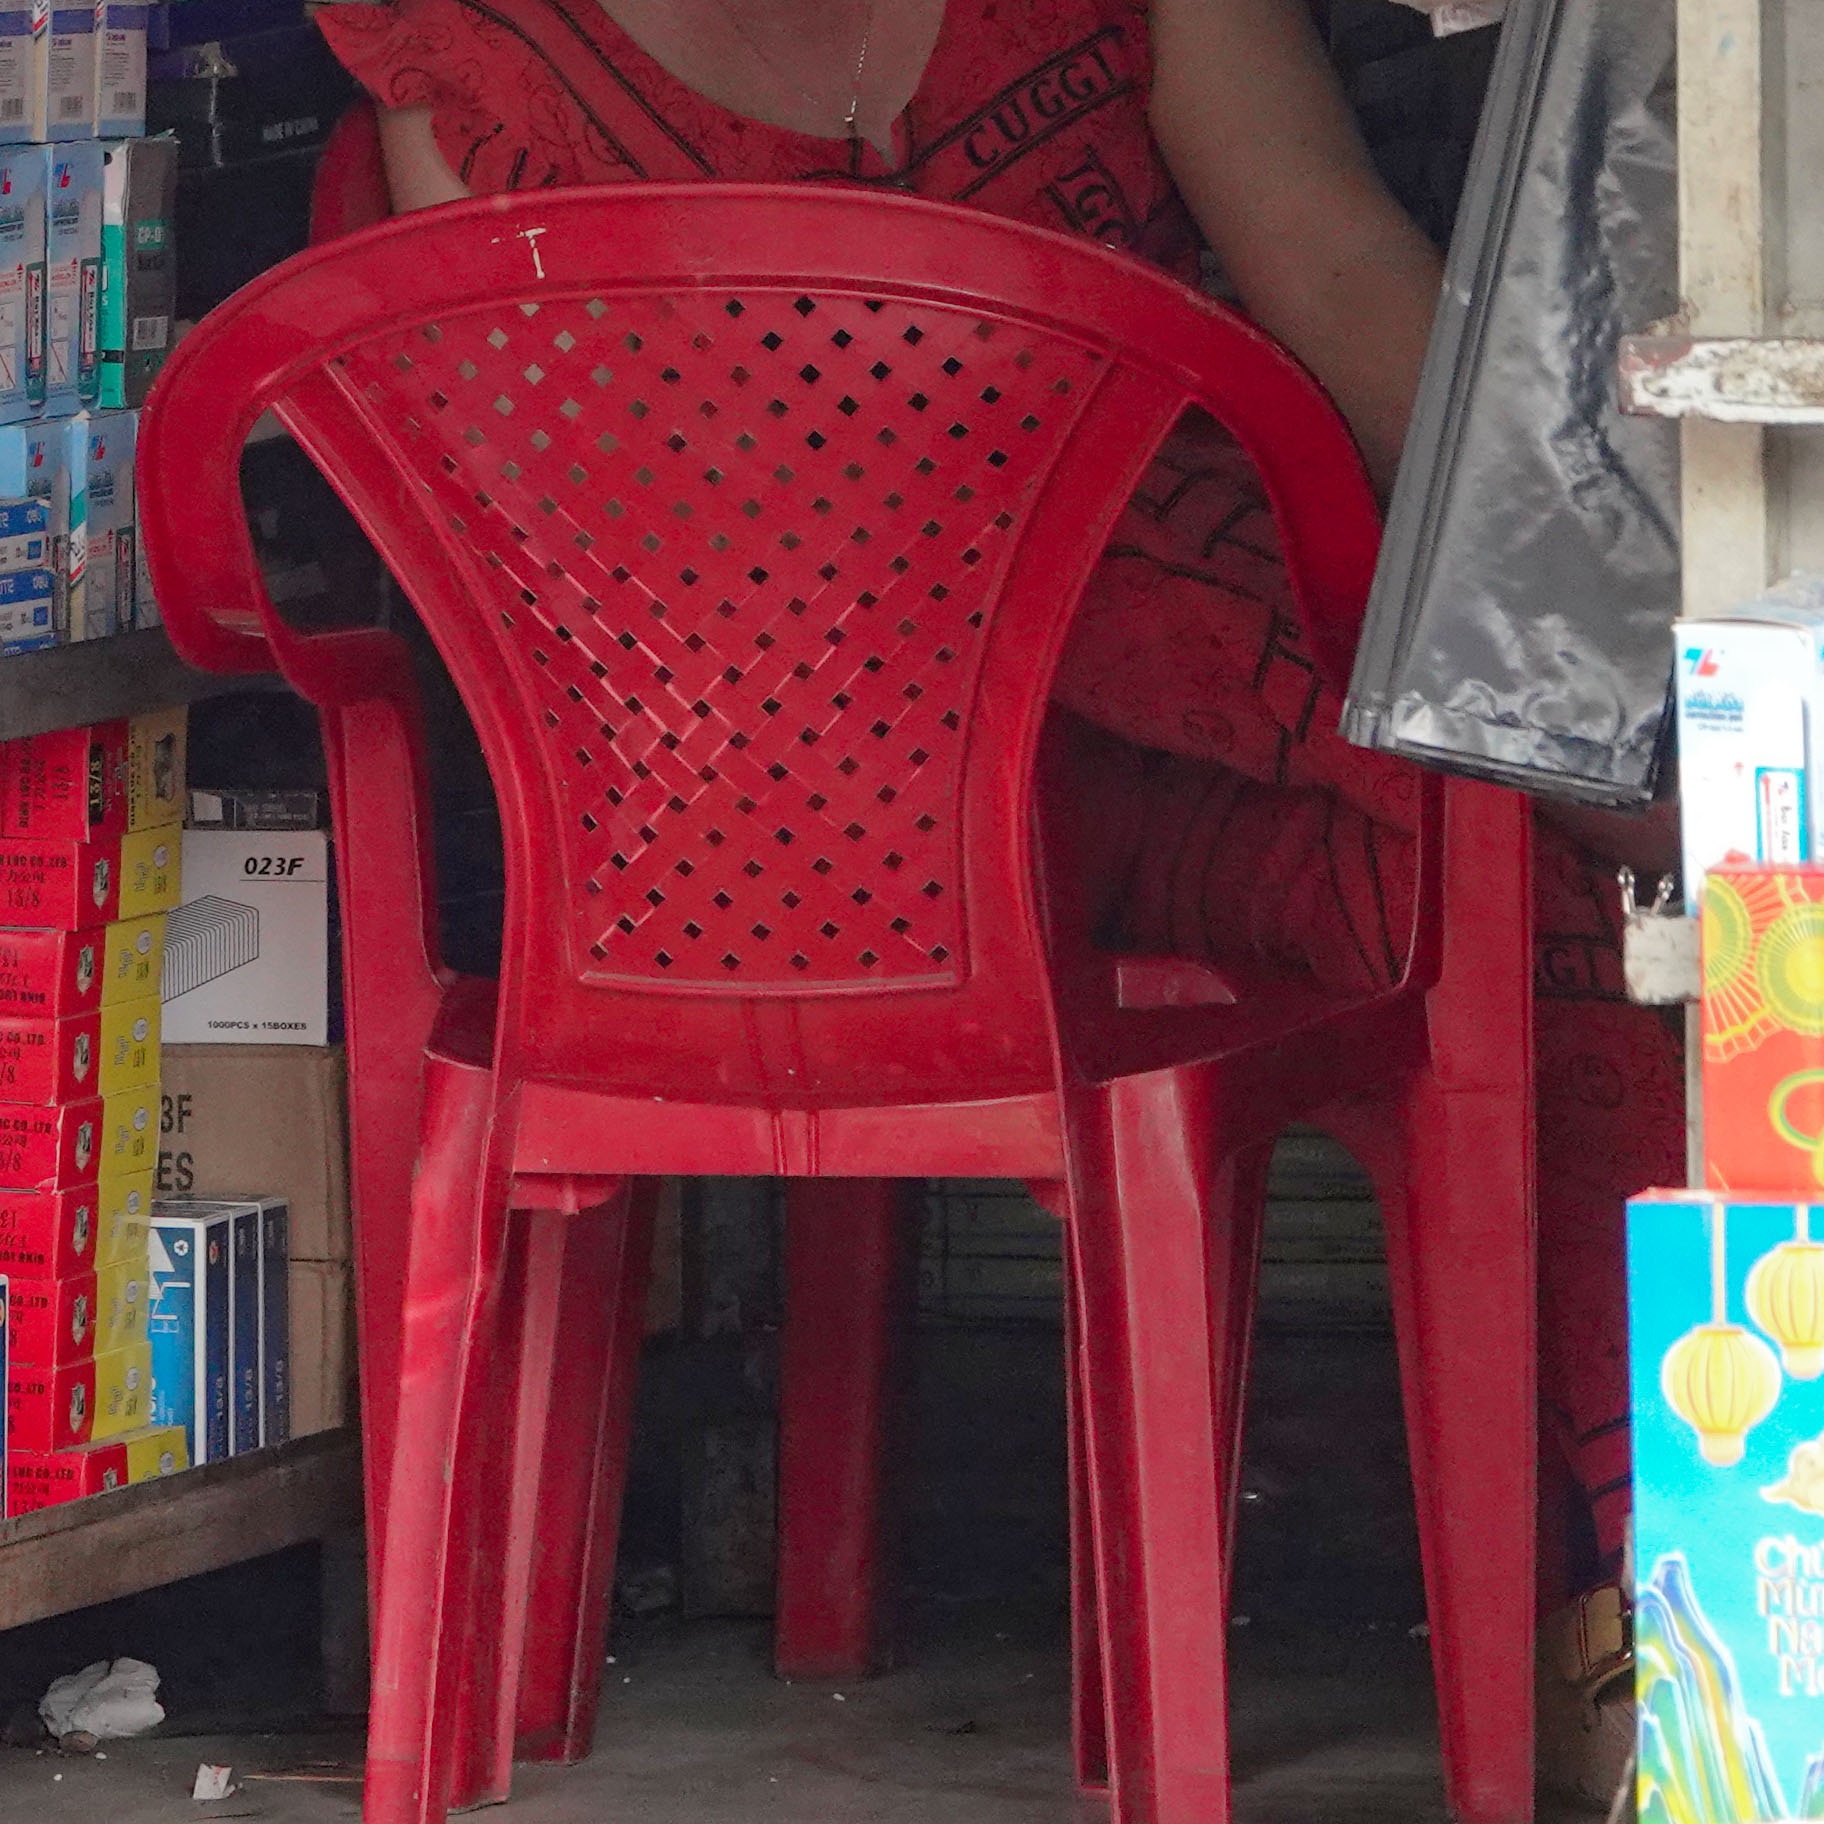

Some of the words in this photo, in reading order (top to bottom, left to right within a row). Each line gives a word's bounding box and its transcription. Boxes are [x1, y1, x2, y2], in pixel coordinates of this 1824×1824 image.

[244, 856, 303, 877] 023F
[7, 887, 40, 908] 13/8
[207, 1020, 250, 1031] 1000PCS
[261, 1021, 307, 1031] 15BOXES
